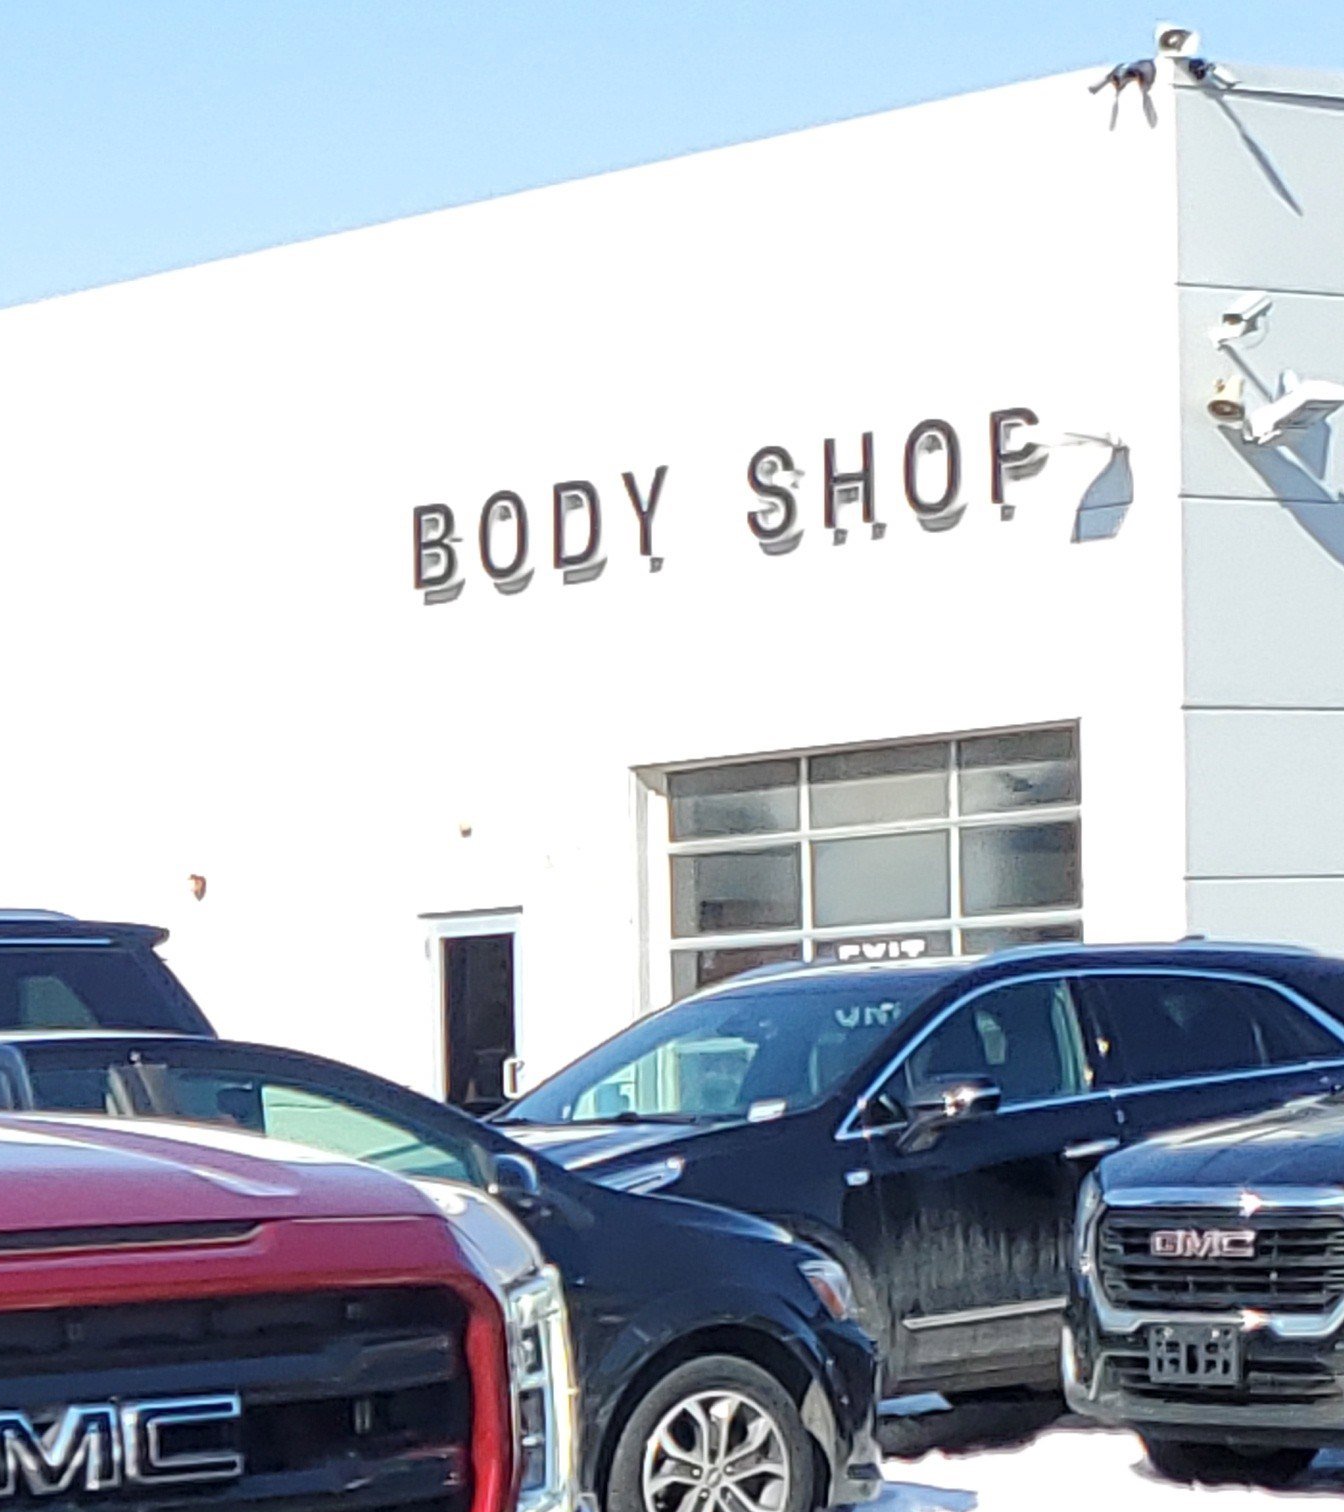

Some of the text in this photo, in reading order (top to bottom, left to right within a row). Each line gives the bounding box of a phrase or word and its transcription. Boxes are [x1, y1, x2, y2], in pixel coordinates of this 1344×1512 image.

[413, 407, 1041, 592] BODY SHOP
[1150, 1228, 1256, 1258] GMC
